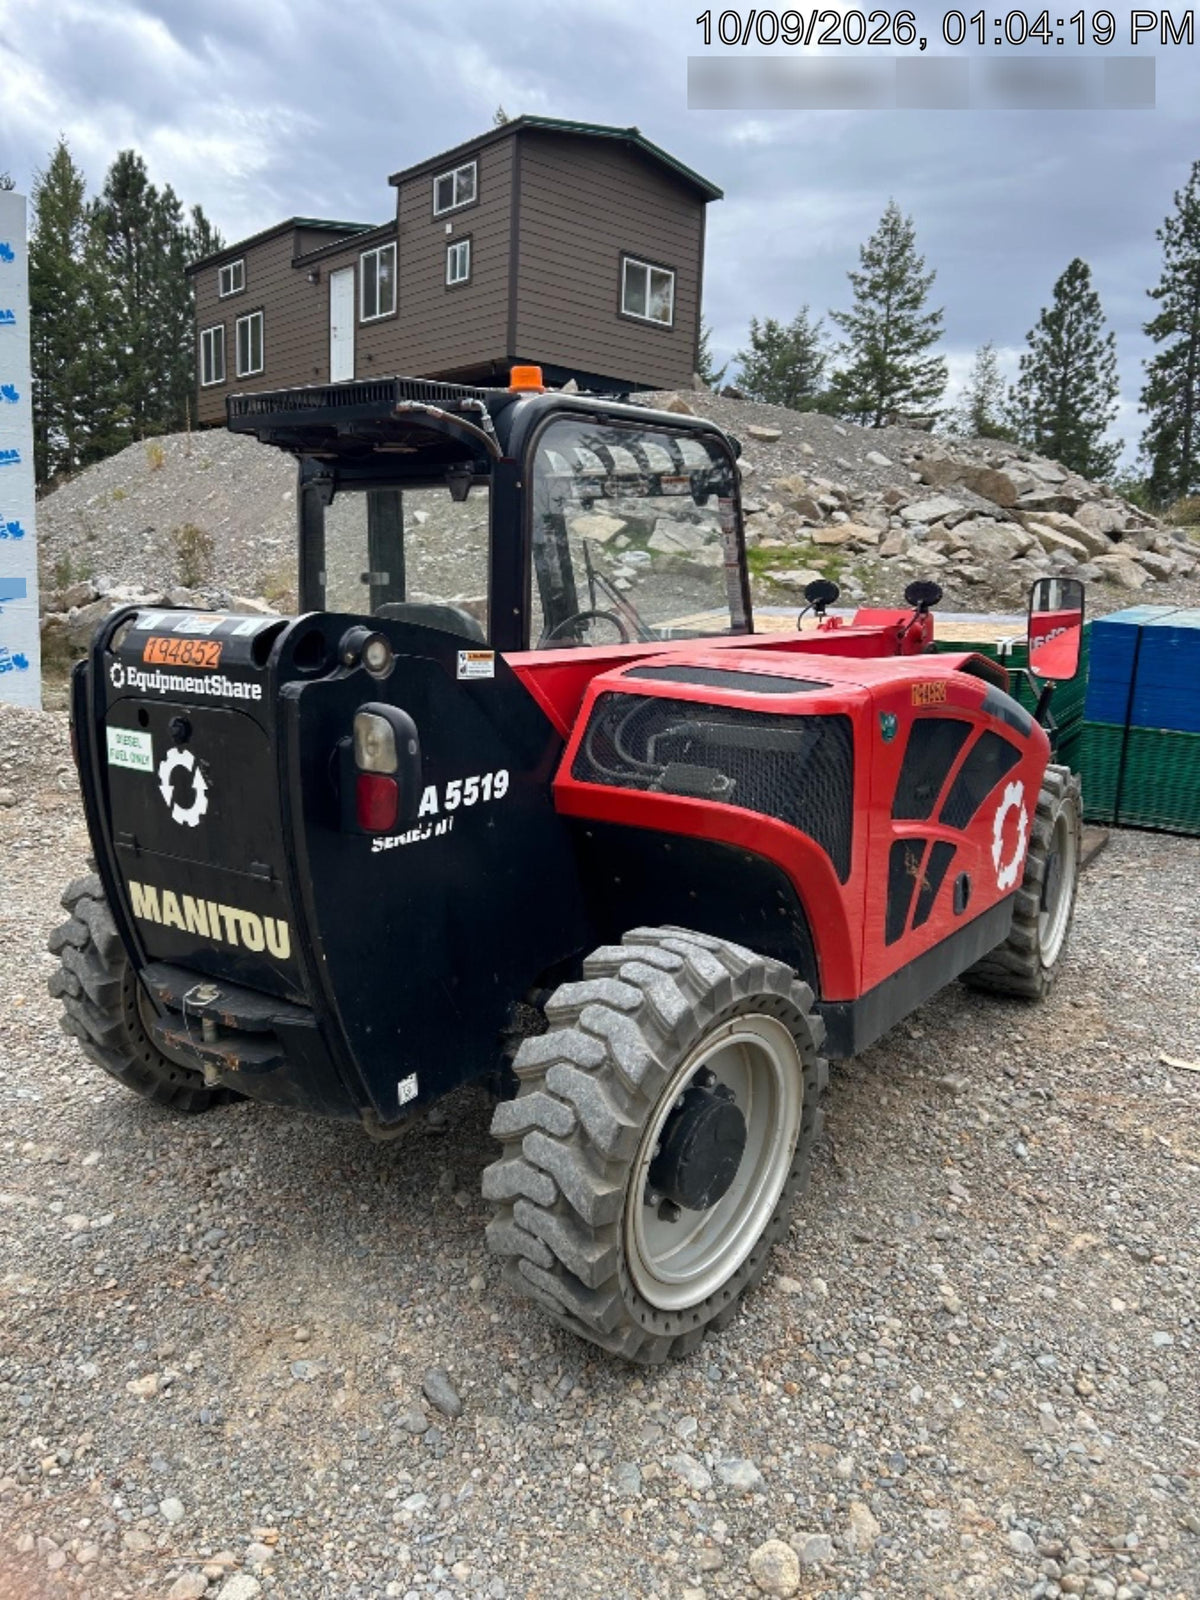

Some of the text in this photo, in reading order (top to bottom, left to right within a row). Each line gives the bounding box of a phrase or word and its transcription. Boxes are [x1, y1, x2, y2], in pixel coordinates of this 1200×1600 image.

[147, 638, 222, 666] 194852
[127, 666, 262, 700] EquipmentShare
[115, 733, 143, 749] DIESEL
[109, 748, 150, 766] FUEL ONLY
[444, 769, 510, 811] 5519
[128, 880, 291, 960] MANITOU
